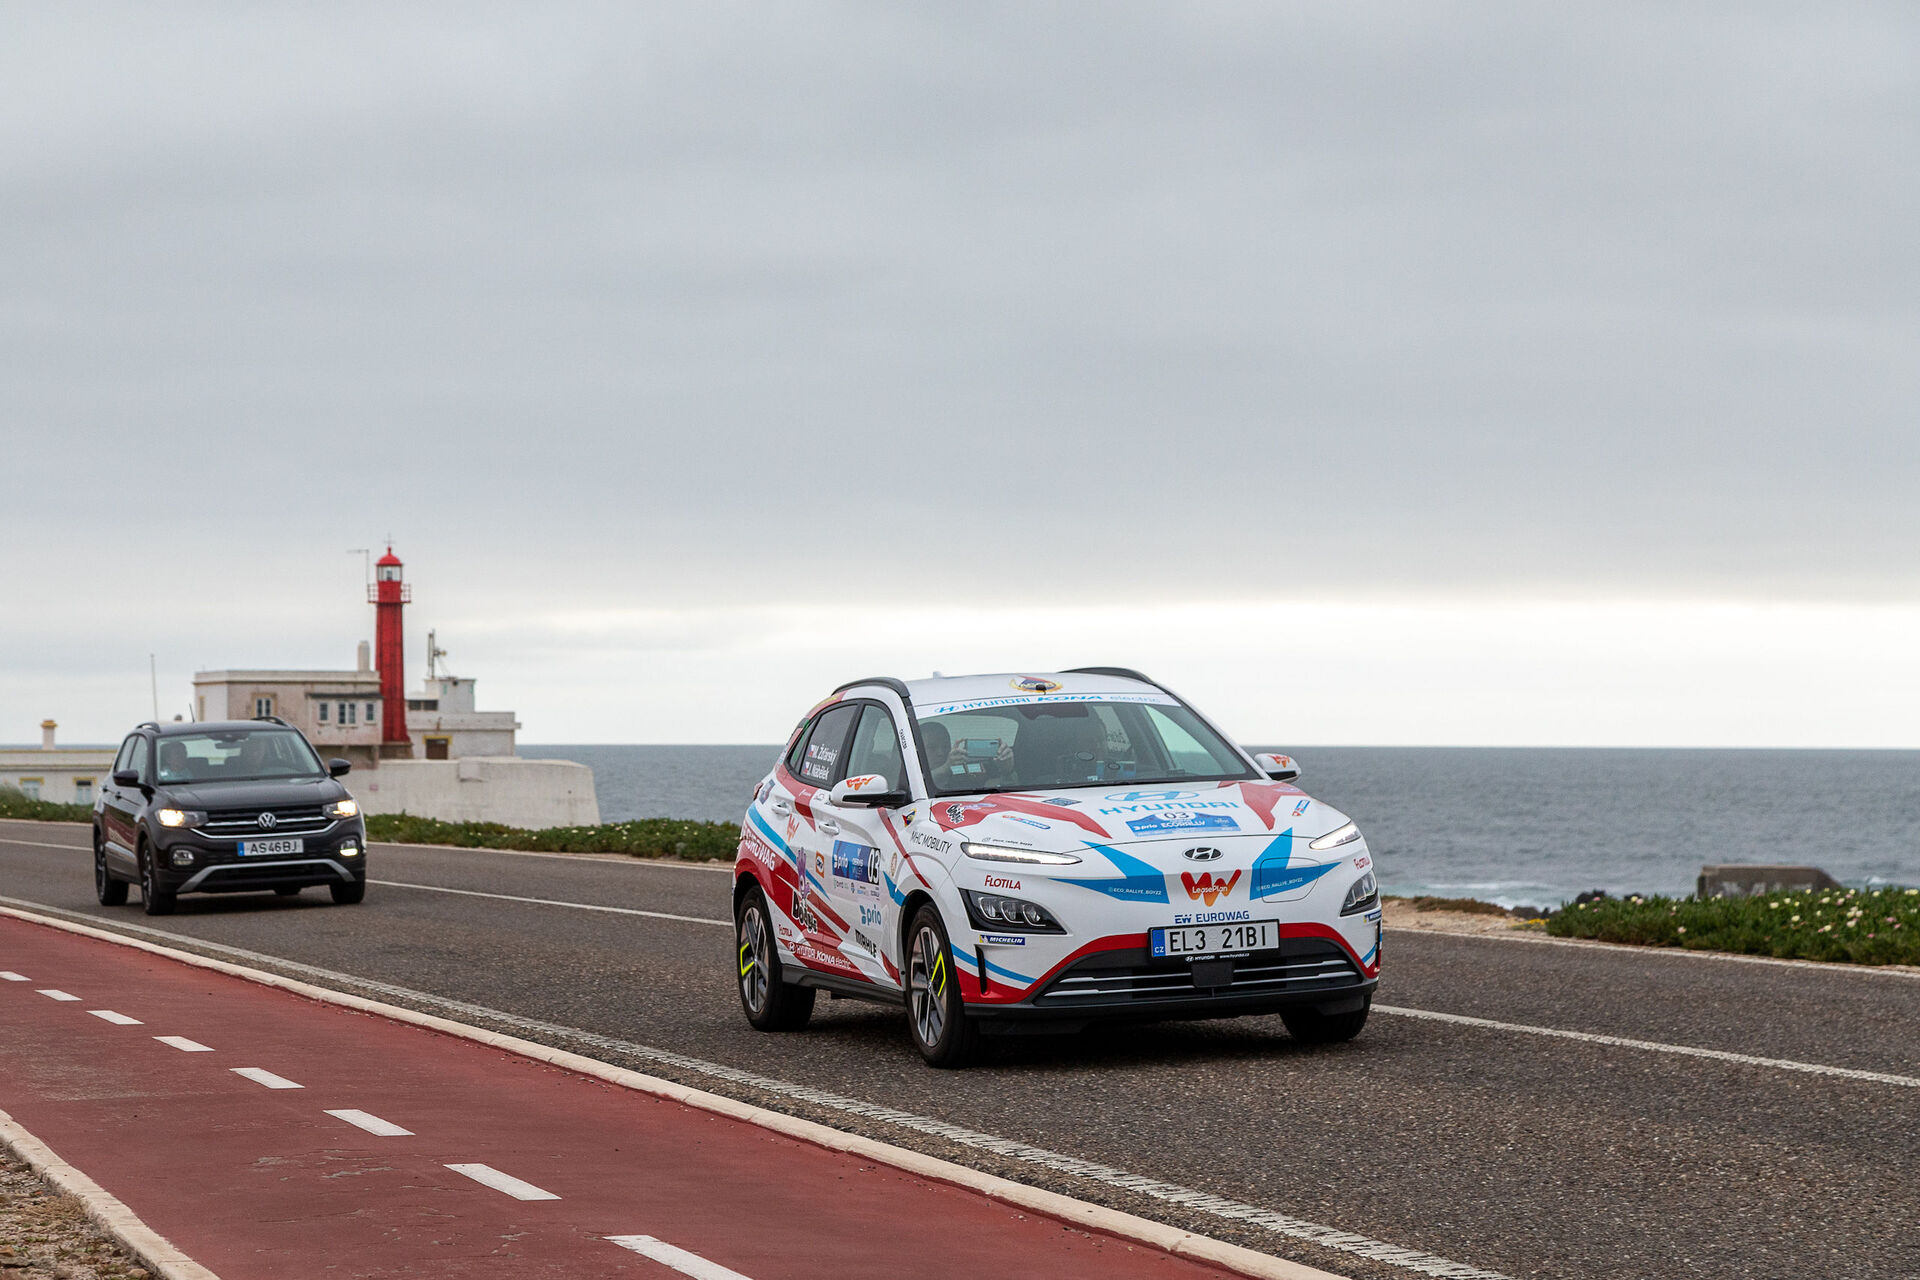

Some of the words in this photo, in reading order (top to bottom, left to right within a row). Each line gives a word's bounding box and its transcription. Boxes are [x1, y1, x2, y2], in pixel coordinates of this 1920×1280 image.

[962, 697, 1031, 710] HYUNDAI
[1037, 695, 1104, 703] KONA
[1099, 801, 1240, 815] HYUNDAI
[1164, 811, 1190, 819] 03
[911, 830, 924, 845] MHC
[922, 834, 953, 854] MOBILITY
[867, 848, 880, 884] 03
[984, 874, 1021, 890] FLOTILA
[1192, 884, 1228, 894] LeasePlan
[866, 903, 881, 926] prio
[1196, 910, 1250, 923] EUROWAG
[1169, 930, 1206, 952] EL3
[1221, 925, 1266, 949] 21BI
[816, 950, 835, 964] KONA
